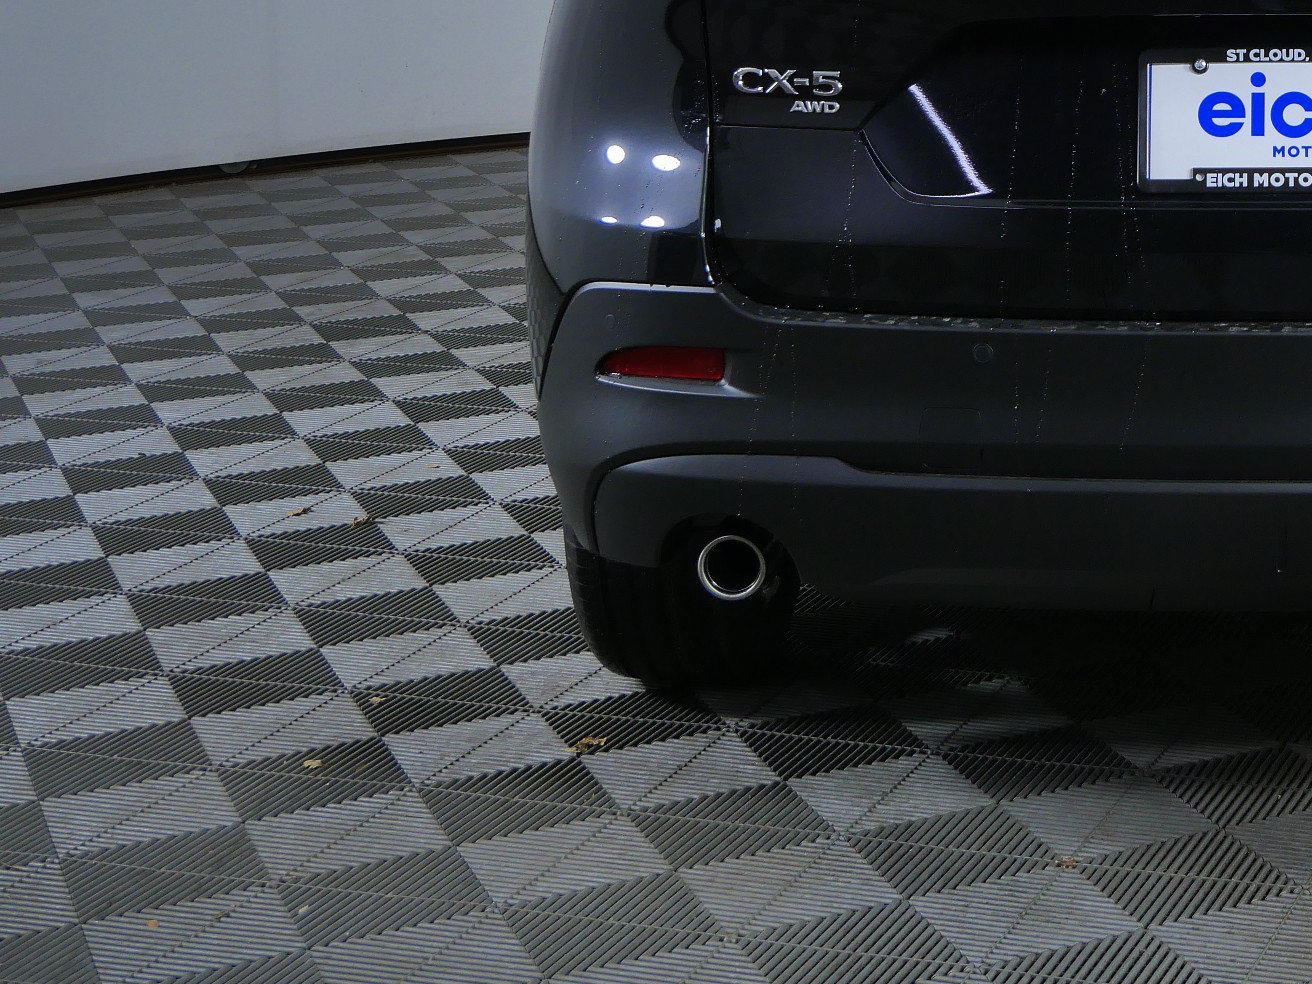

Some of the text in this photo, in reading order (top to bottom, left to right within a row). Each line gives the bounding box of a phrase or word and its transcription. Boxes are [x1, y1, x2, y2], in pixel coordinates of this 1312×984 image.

[1226, 49, 1246, 62] ST
[1249, 49, 1310, 62] CLOUD,
[732, 67, 843, 96] CX-5
[789, 100, 840, 114] AWD
[1206, 172, 1248, 188] EICH
